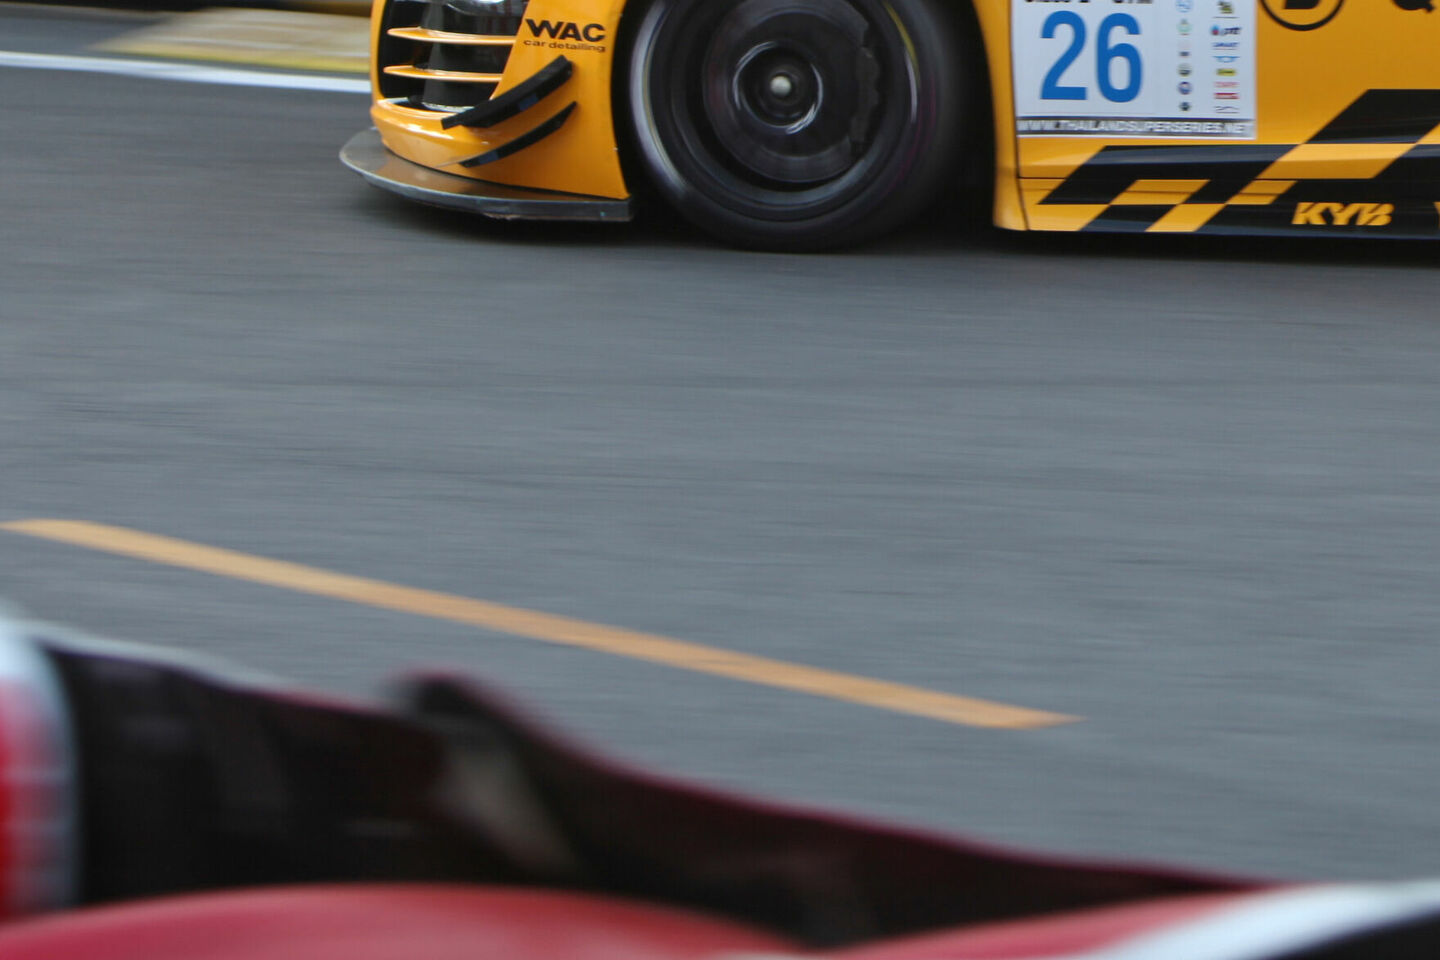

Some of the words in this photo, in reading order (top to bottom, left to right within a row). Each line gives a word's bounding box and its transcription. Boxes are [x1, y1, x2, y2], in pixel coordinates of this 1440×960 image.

[525, 18, 606, 43] WAC
[523, 39, 546, 47] car
[548, 41, 606, 53] detailing
[1040, 10, 1143, 103] 26
[1292, 202, 1395, 226] KYB
